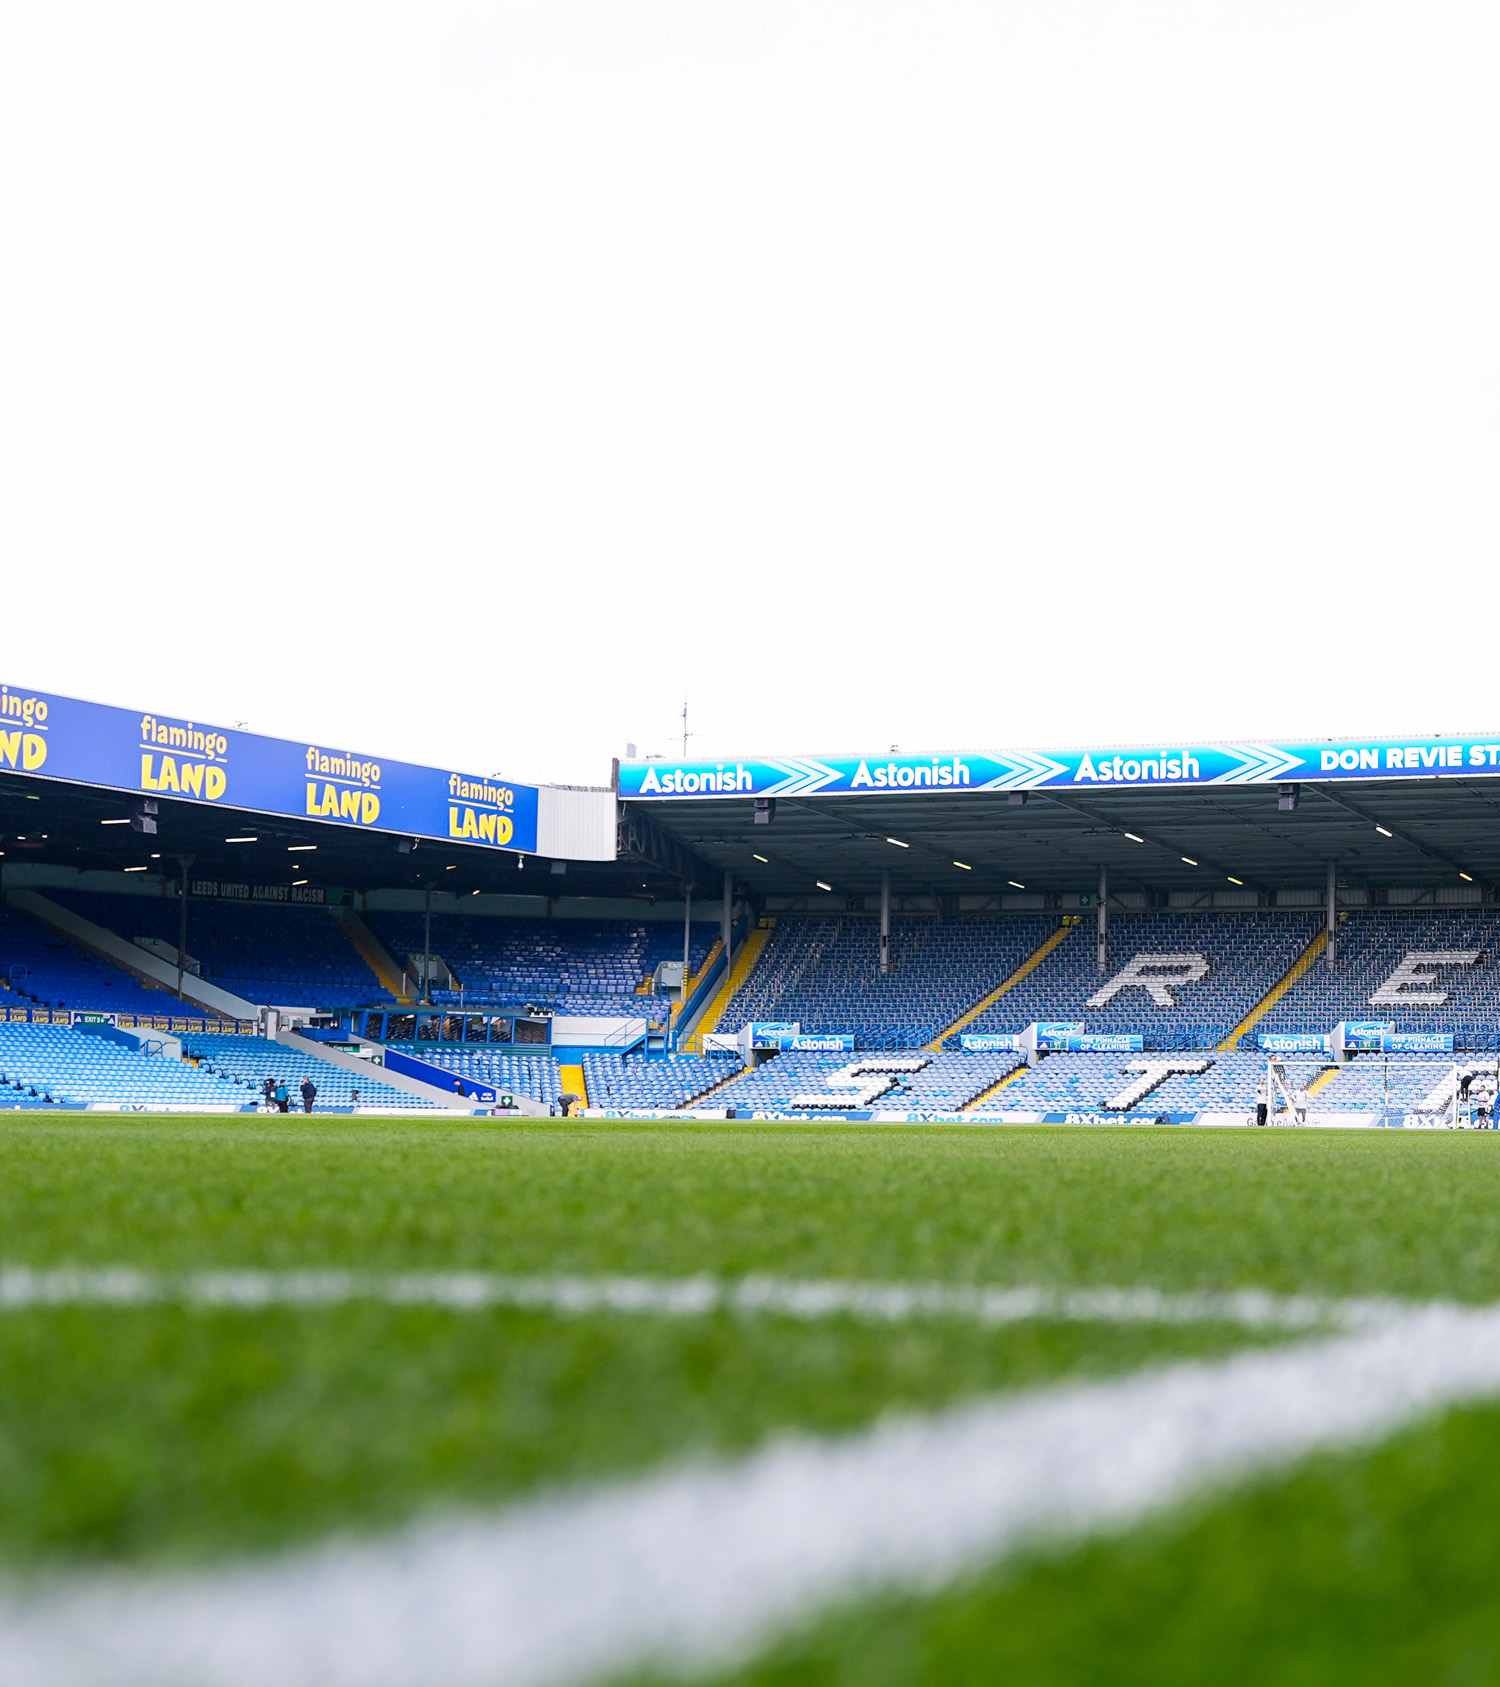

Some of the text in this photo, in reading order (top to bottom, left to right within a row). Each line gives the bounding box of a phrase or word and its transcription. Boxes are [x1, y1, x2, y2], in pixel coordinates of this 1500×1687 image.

[140, 715, 228, 760] flamingo
[305, 747, 381, 787] flamingo
[1073, 750, 1200, 782] Astonish
[1320, 748, 1382, 771] DON
[1386, 744, 1462, 769] REVIE
[141, 754, 227, 800] LAND
[638, 763, 753, 794] Astonish
[850, 757, 970, 791] Astonish
[306, 783, 380, 824] LAND
[448, 774, 514, 810] flamingo
[449, 807, 513, 845] LAND
[192, 880, 324, 903] LEEDS UNITED AGAINST RACISM
[790, 1037, 843, 1050] Astonish
[962, 1037, 1012, 1051] Astonish
[1262, 1037, 1321, 1051] Astonish
[752, 1112, 846, 1121] 8Xbetcom
[907, 1113, 1003, 1123] 8Xbetcom
[1065, 1113, 1155, 1124] 8Xbet.co
